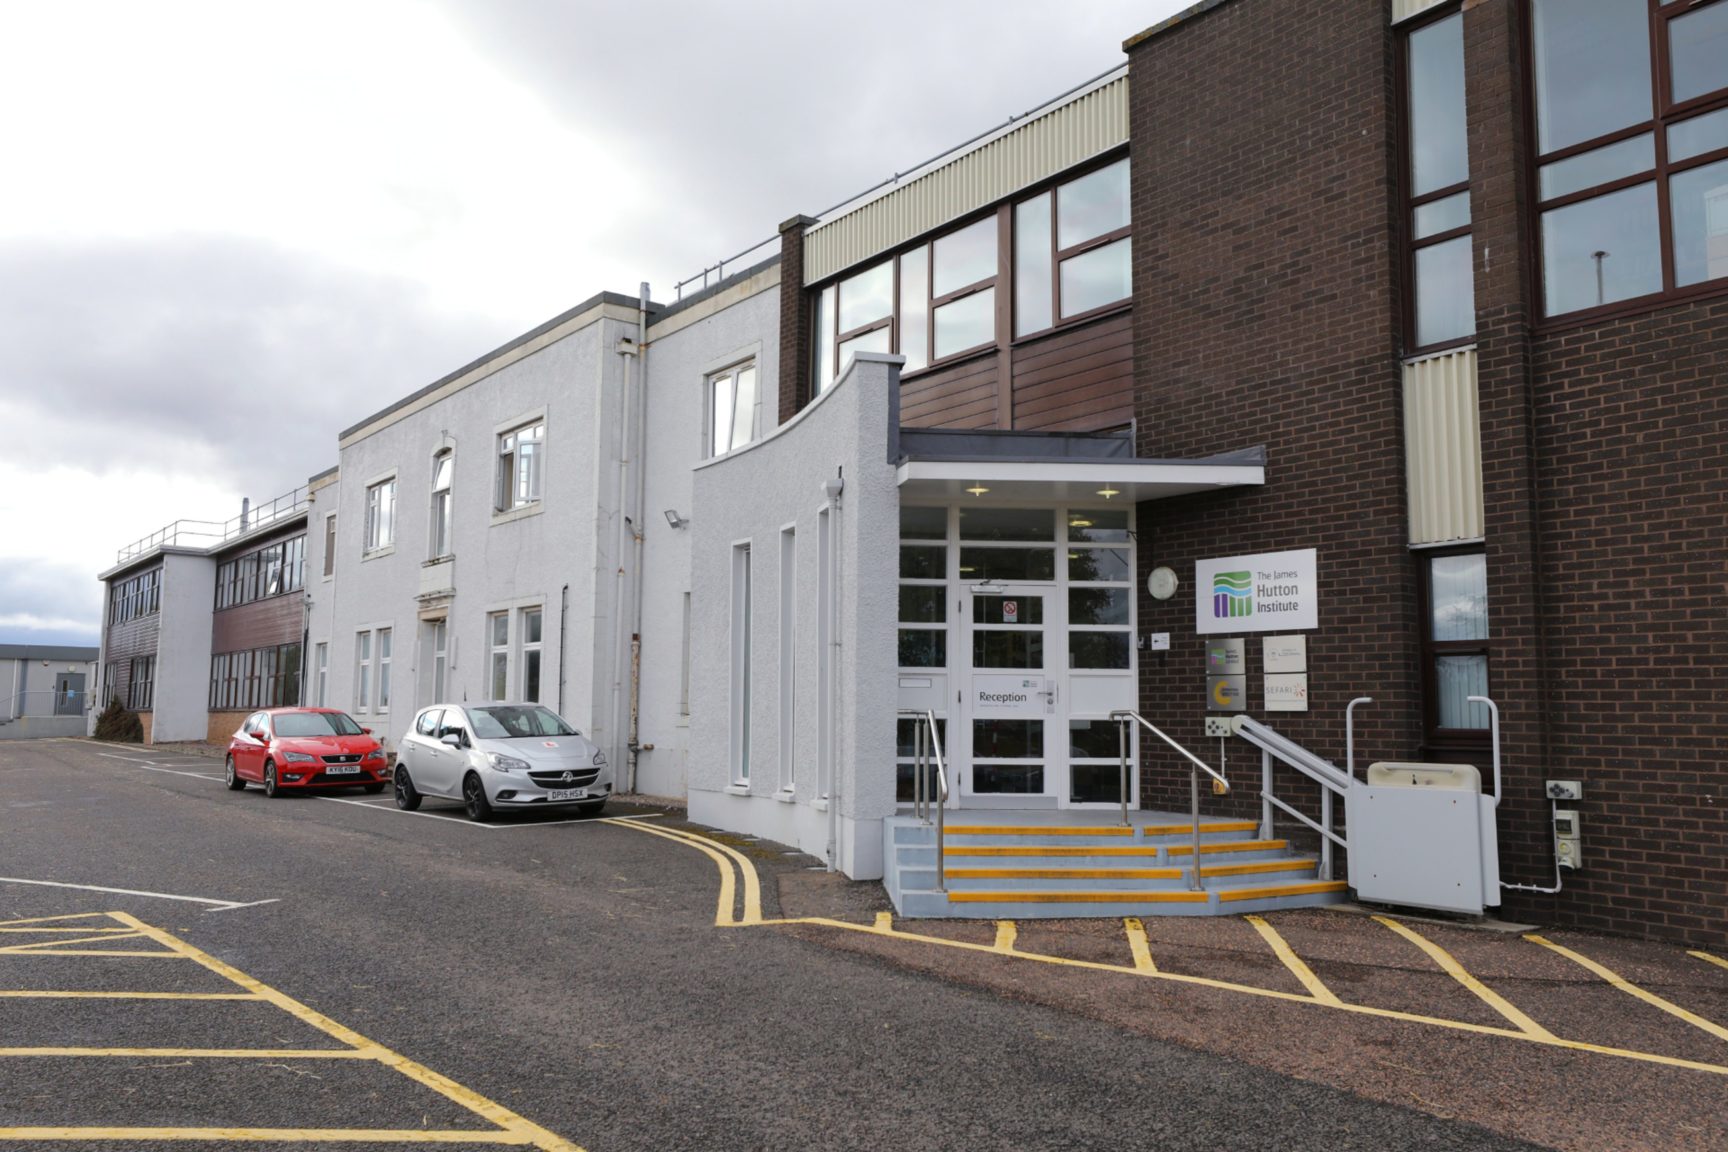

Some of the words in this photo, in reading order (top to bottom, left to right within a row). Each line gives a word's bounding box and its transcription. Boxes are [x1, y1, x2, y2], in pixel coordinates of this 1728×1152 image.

[1257, 571, 1271, 581] The
[1273, 570, 1298, 580] James
[1257, 584, 1298, 598] Hutton
[1257, 601, 1299, 613] Institute
[1265, 686, 1292, 695] SEFARI
[979, 691, 1027, 704] Reception
[552, 791, 568, 799] DP15
[569, 790, 584, 798] HSX
